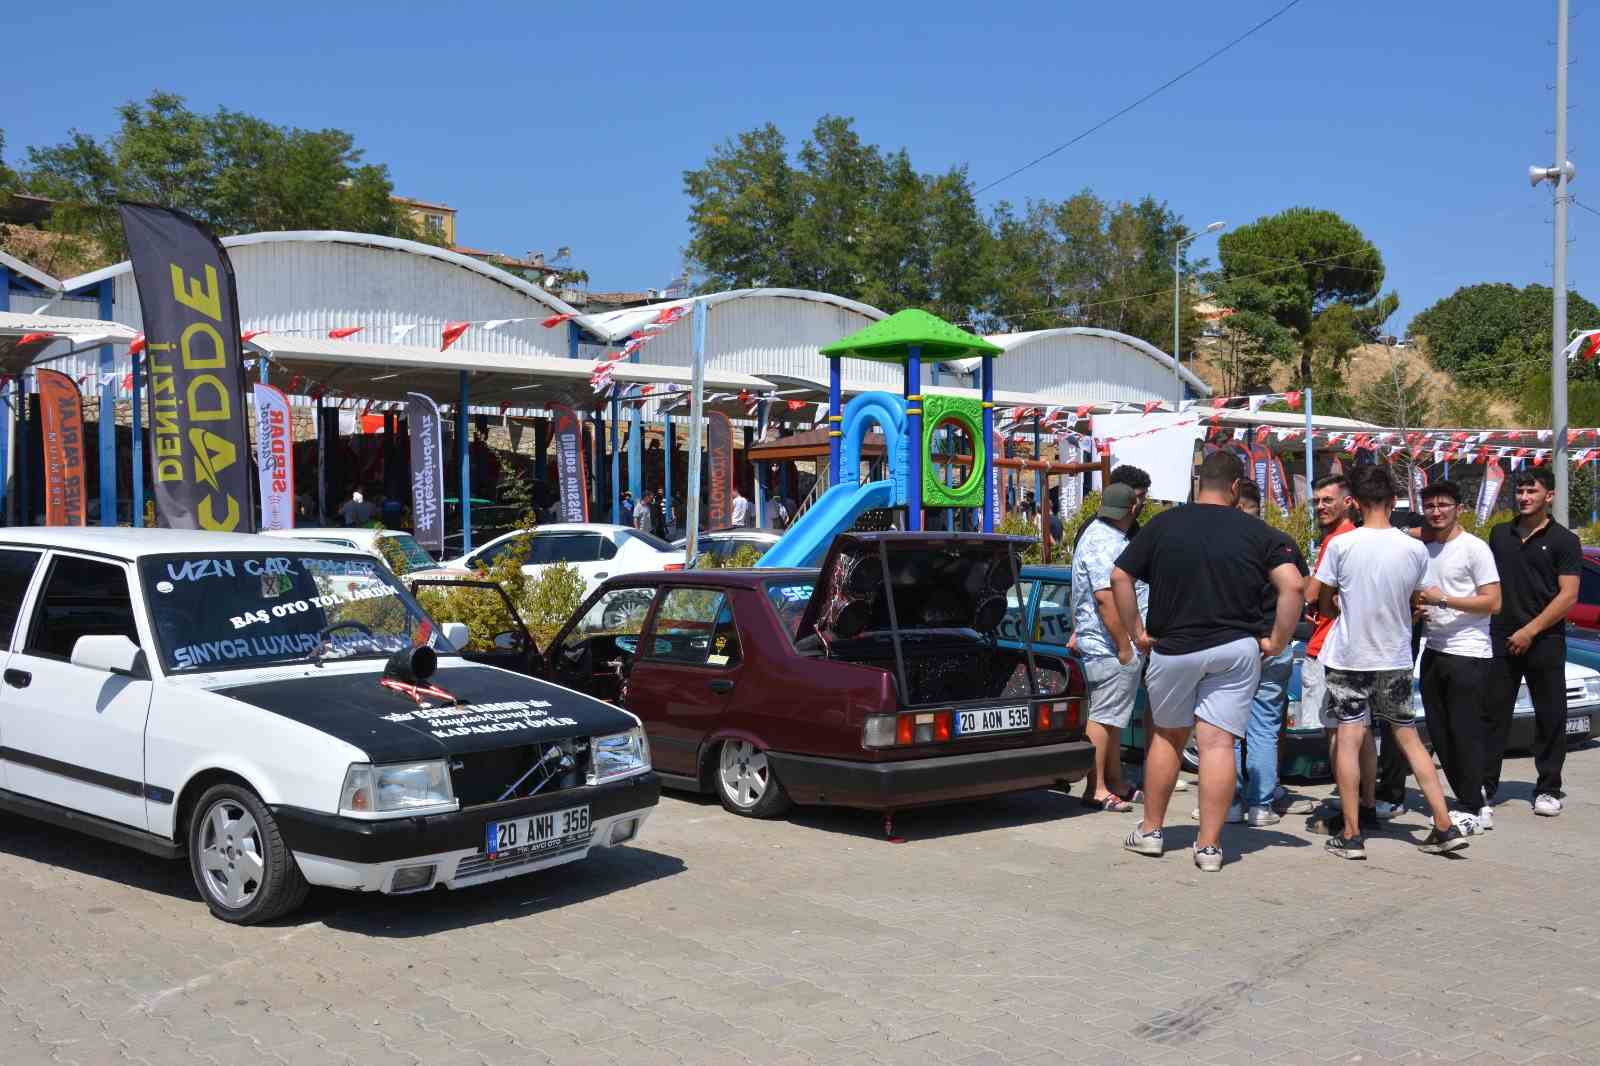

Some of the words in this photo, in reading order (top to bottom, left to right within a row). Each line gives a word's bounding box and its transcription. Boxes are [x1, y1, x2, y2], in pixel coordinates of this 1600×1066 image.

[229, 609, 270, 629] BAŞ
[273, 600, 309, 618] OTO
[309, 594, 344, 608] YOL
[960, 714, 975, 732] 20
[983, 711, 1003, 729] AON
[1008, 709, 1029, 727] 535
[498, 823, 517, 848] 20
[527, 815, 554, 842] ANH
[562, 808, 588, 833] 356
